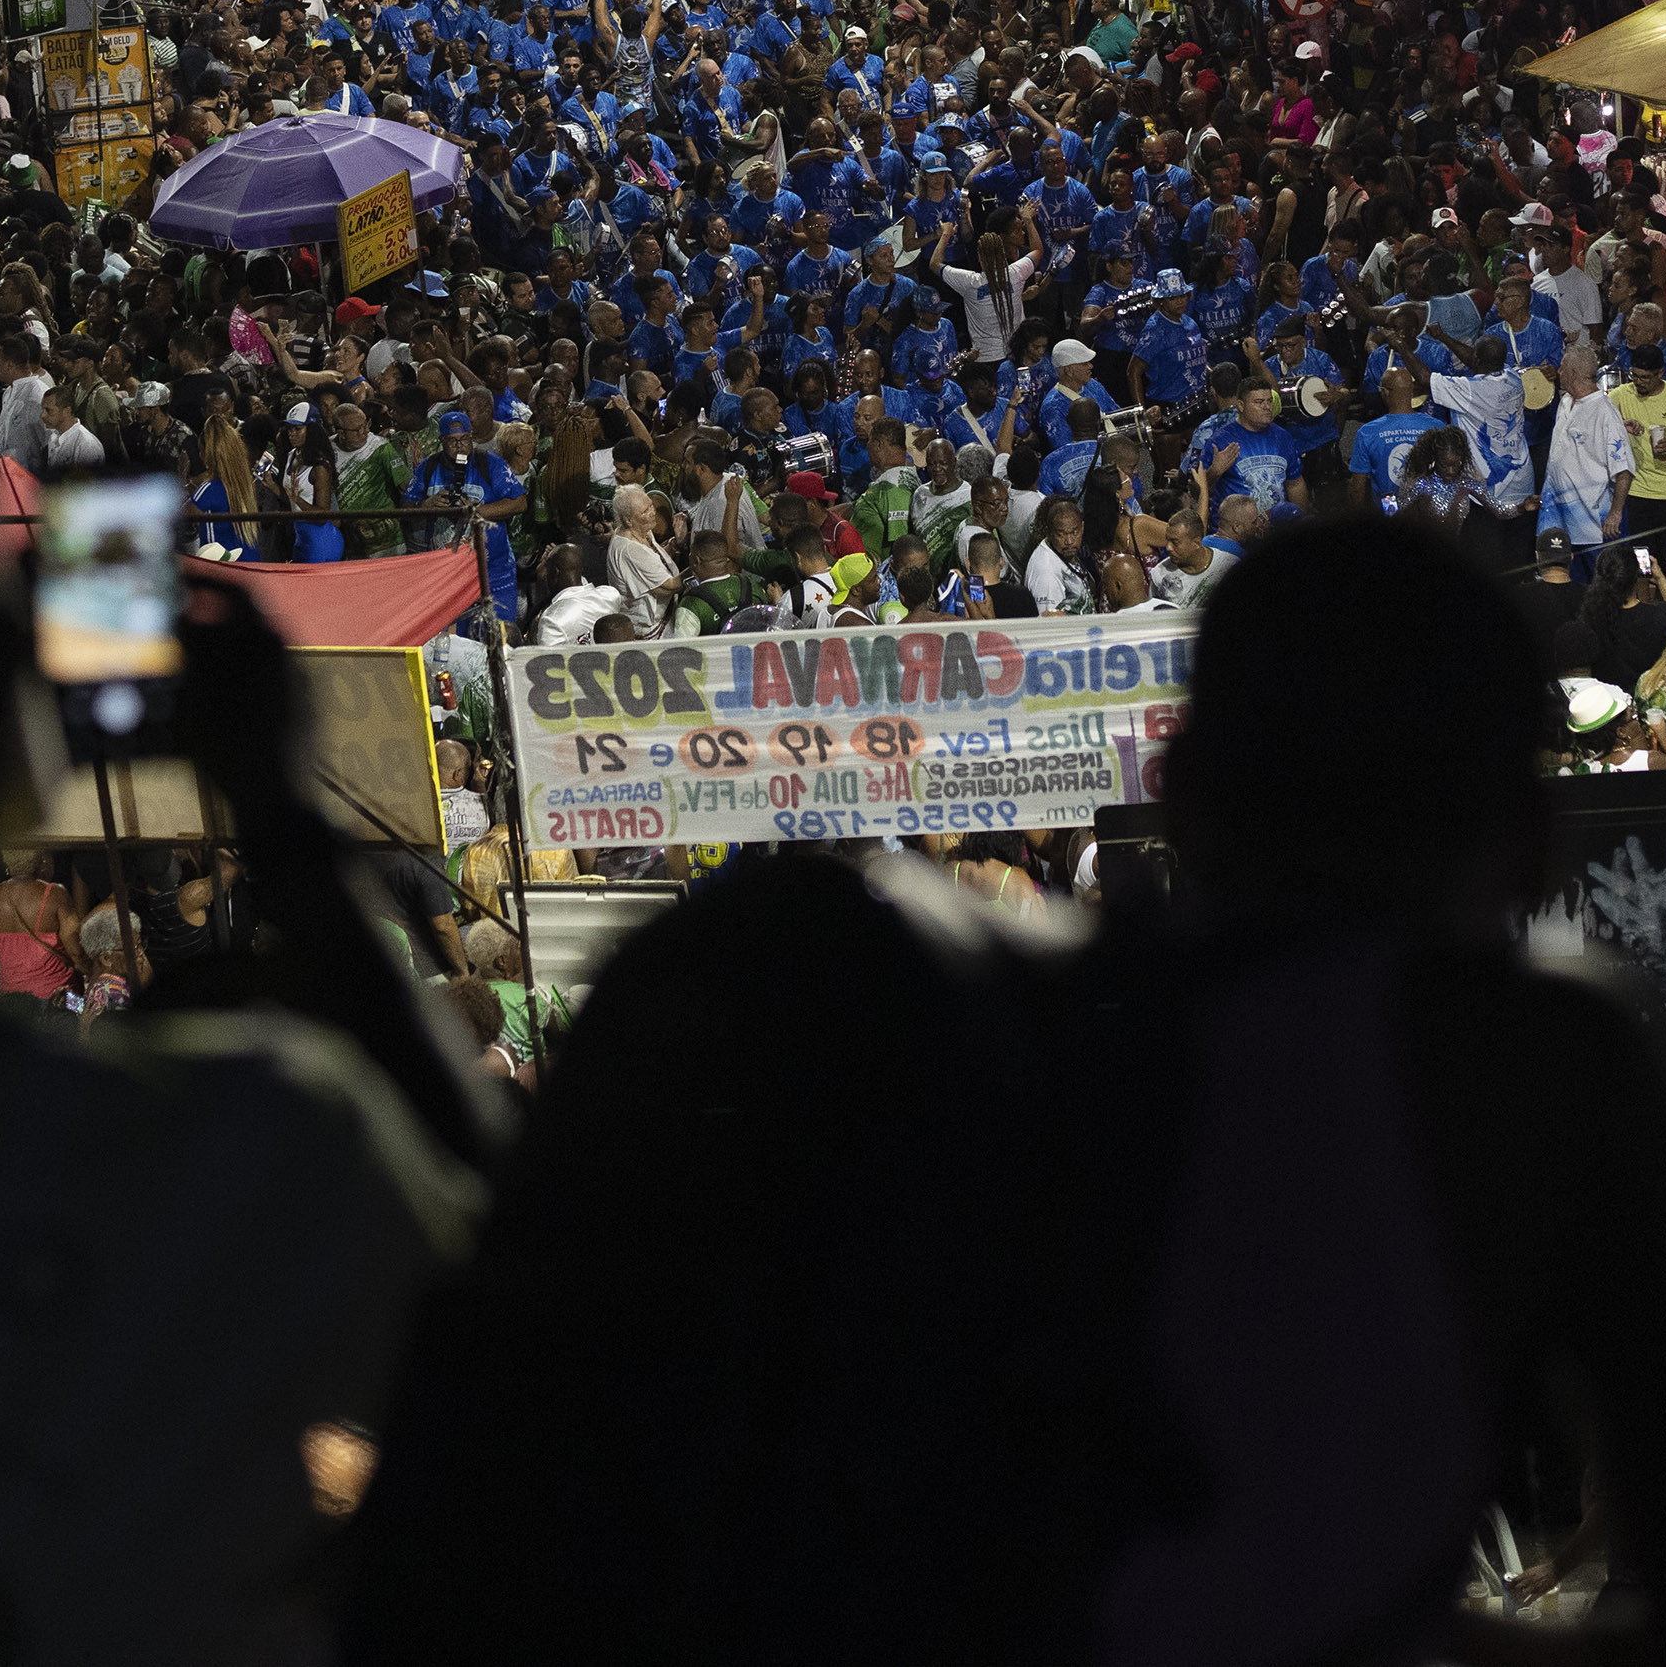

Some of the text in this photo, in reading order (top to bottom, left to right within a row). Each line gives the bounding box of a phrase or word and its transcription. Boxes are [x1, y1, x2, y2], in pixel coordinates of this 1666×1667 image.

[47, 36, 85, 55] BALDE
[113, 36, 131, 47] GELO
[48, 51, 85, 72] LATÃO
[346, 181, 404, 220] PROMOÇÃO
[348, 204, 384, 237] LATÃO
[1379, 428, 1425, 439] DEPARTAMENT
